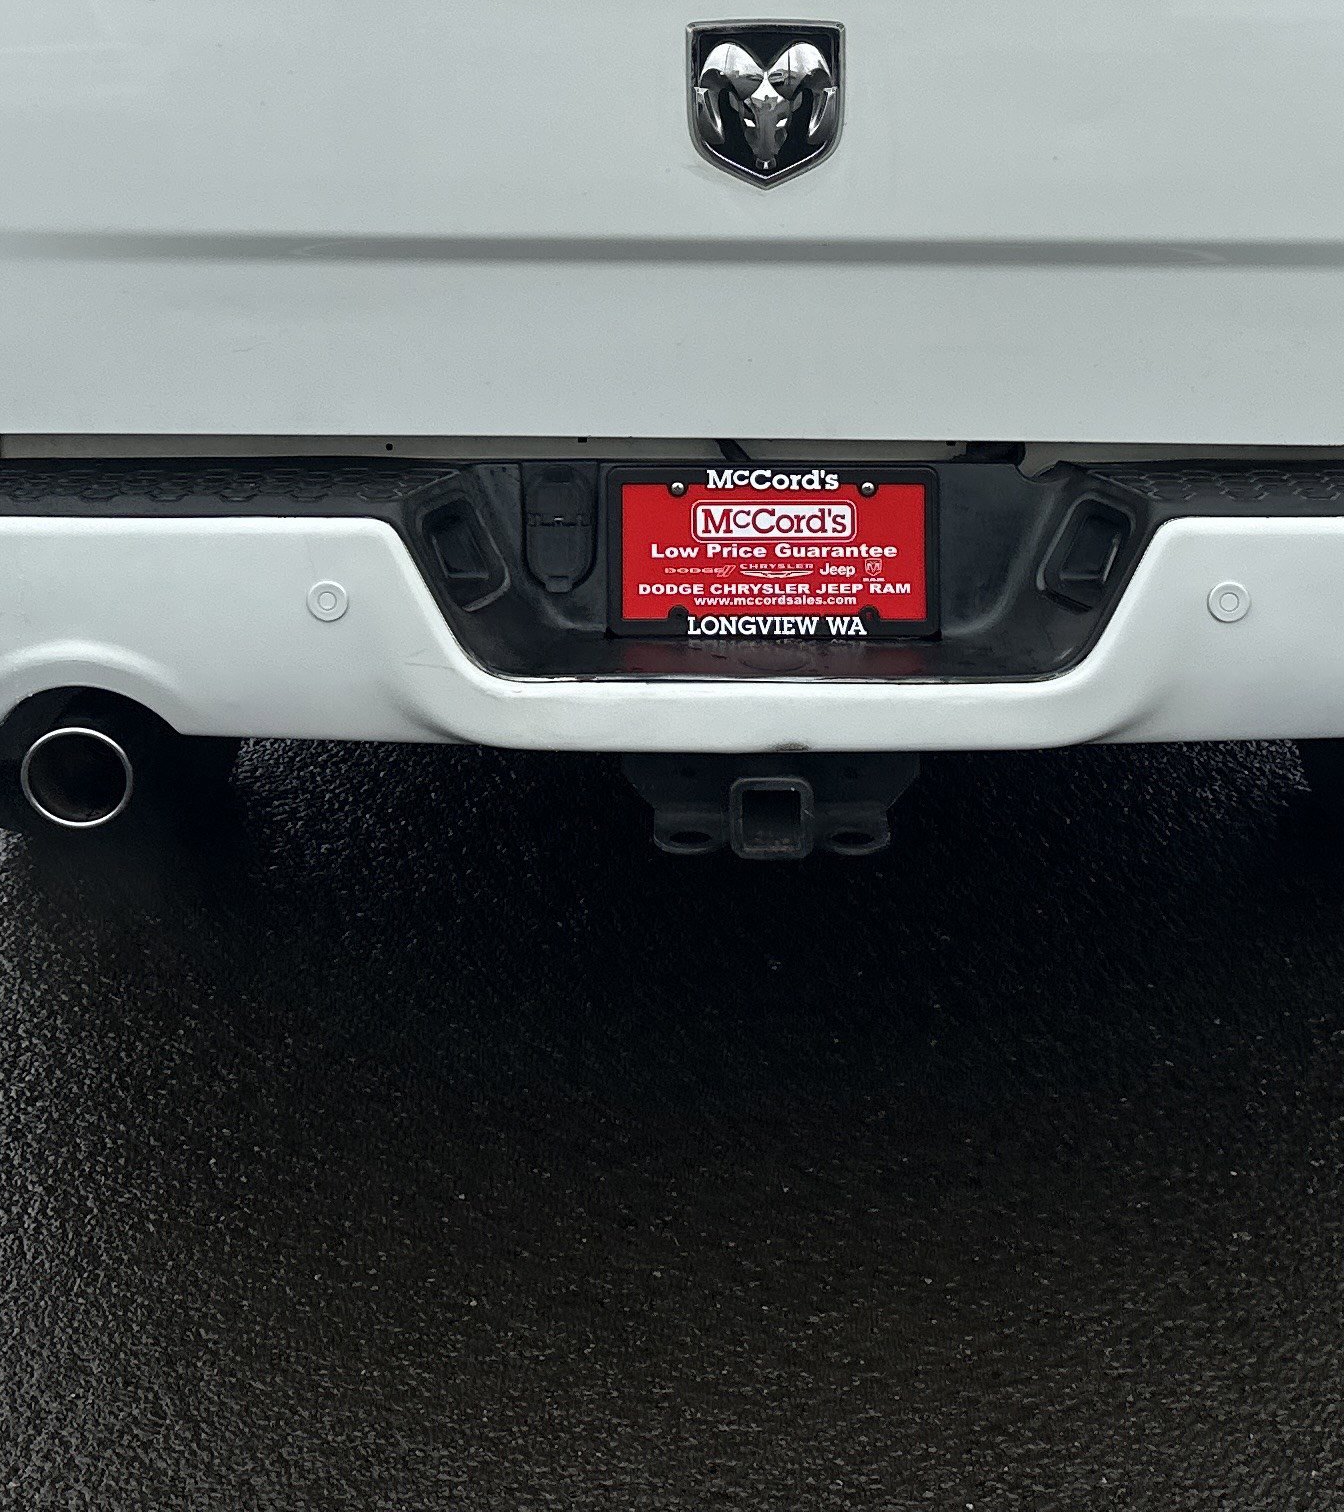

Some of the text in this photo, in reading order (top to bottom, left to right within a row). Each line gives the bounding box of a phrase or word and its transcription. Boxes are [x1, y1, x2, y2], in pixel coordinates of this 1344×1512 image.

[706, 469, 840, 491] McCord's
[701, 508, 847, 535] McCord's
[651, 543, 898, 559] Low Price Guarantee
[819, 562, 856, 578] Jeep
[638, 583, 911, 595] DODGE CHRYSLER JEEP RAM
[693, 594, 857, 606] www.mccordsales.com
[687, 616, 868, 636] LONGVIEW WA
